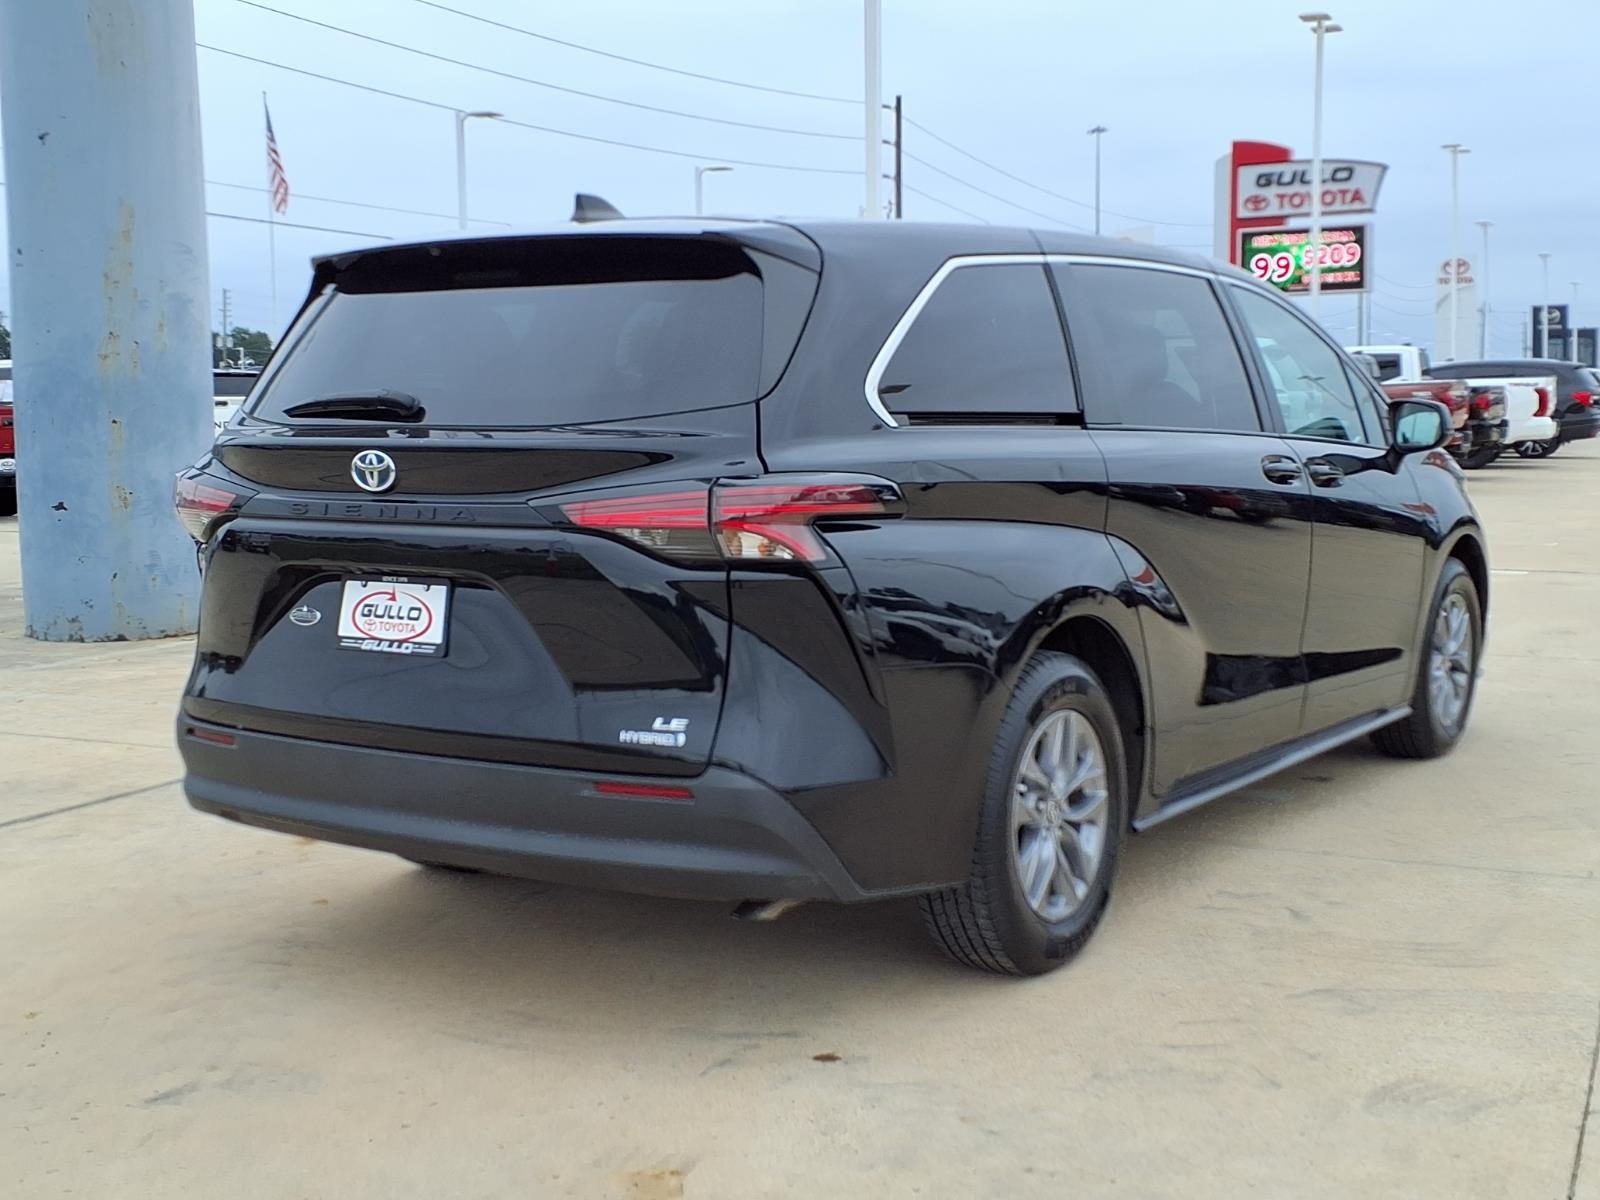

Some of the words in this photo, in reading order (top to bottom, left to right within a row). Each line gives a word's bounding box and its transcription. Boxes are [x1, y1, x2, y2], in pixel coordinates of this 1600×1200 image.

[1255, 167, 1355, 188] GULO
[1251, 253, 1294, 281] 99
[291, 503, 476, 521] SIENNA
[360, 603, 423, 621] GULLO
[377, 621, 417, 634] TOYOTA
[360, 640, 414, 654] GULLO
[651, 717, 689, 731] LE
[619, 730, 676, 746] HYBRID
